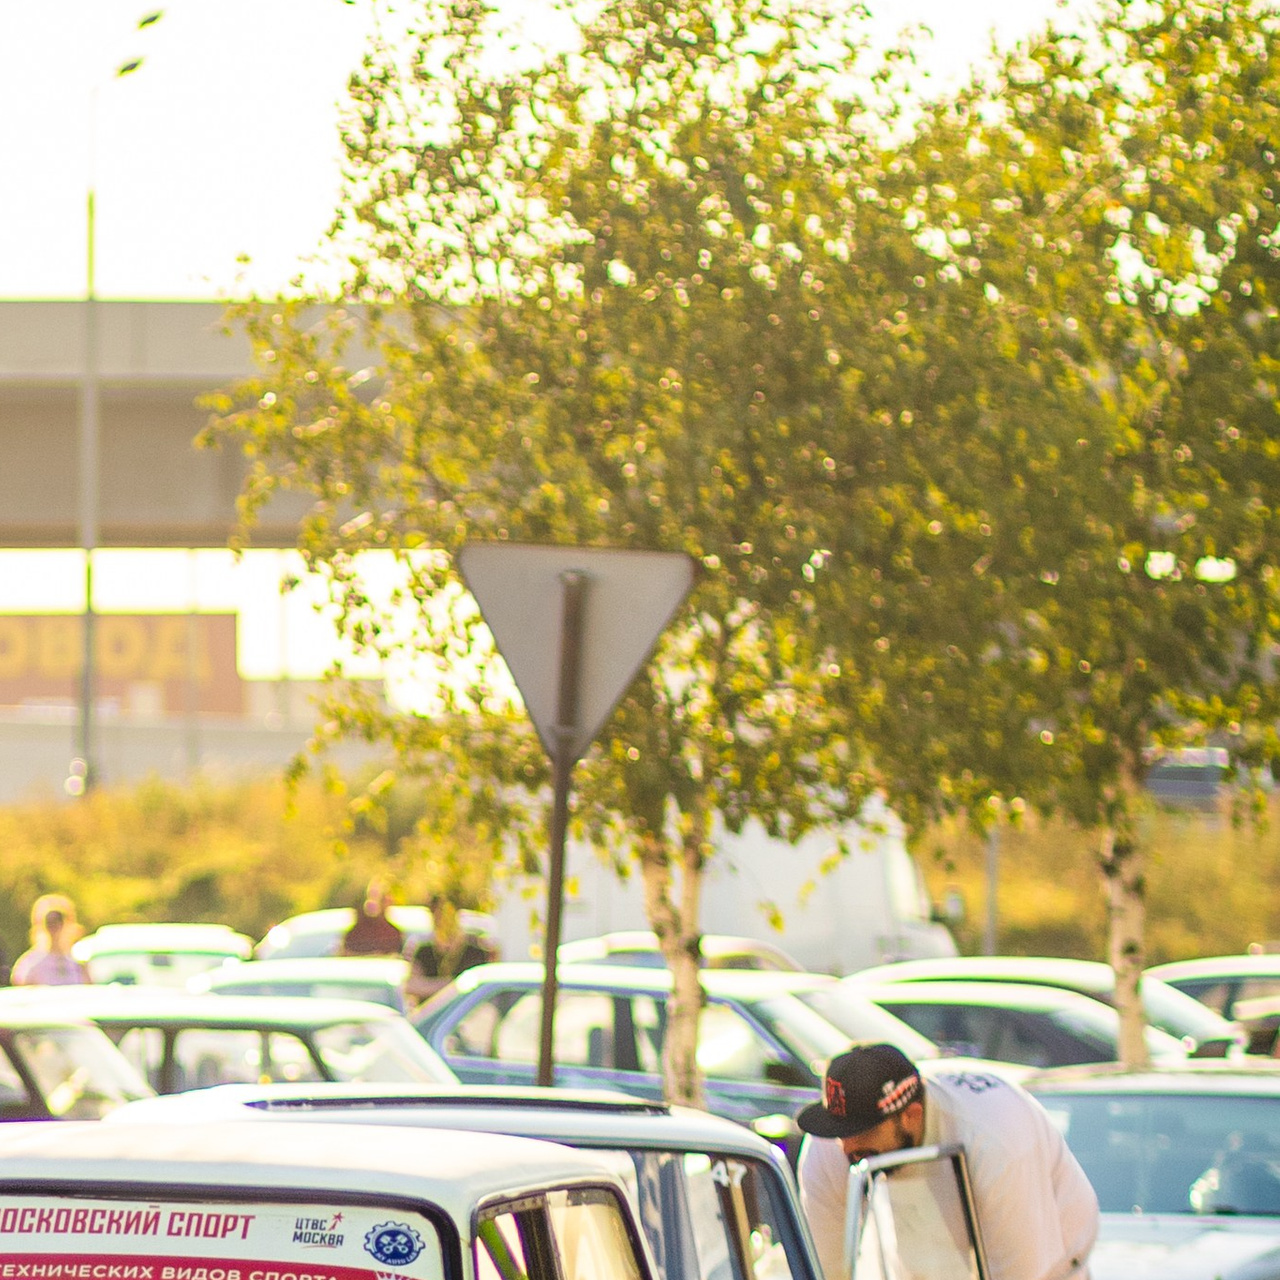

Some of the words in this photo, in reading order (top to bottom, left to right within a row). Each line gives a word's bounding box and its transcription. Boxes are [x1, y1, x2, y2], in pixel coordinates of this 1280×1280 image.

[710, 1159, 747, 1188] 47
[166, 1211, 256, 1240] СПОРТ
[295, 1217, 327, 1231] ЦТВС
[292, 1230, 344, 1247] МОСКВА
